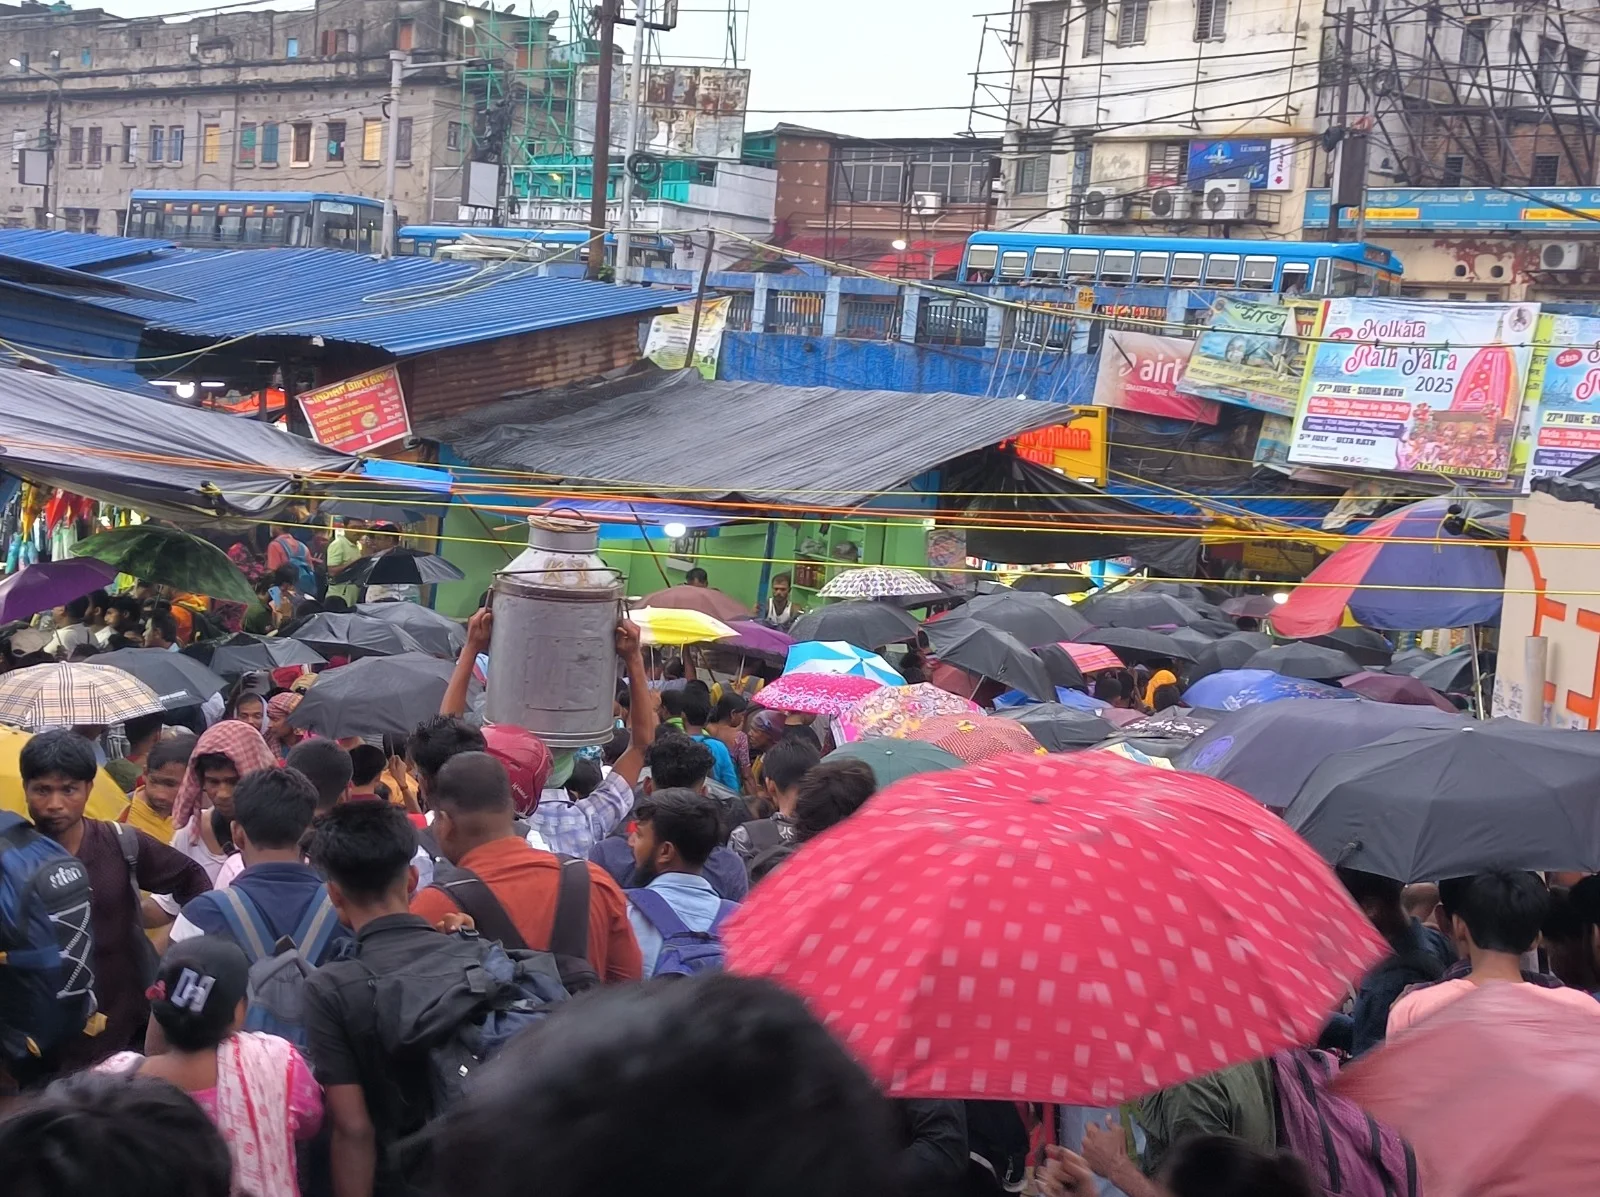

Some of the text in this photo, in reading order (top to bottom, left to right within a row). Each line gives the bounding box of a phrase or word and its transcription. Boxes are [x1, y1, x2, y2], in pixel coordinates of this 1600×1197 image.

[1357, 318, 1426, 339] Kolkata
[1345, 344, 1458, 376] Rath Yatra
[1140, 353, 1184, 386] airt
[1125, 383, 1168, 397] SMARTPHONE
[1333, 385, 1352, 394] JUNE
[1383, 388, 1405, 398] RATH
[1414, 376, 1455, 394] 2025
[1564, 413, 1585, 424] JUNE
[1540, 428, 1561, 439] Mela
[1312, 435, 1329, 443] JULY
[1356, 439, 1377, 447] RATH
[1436, 465, 1457, 475] ARE
[1459, 467, 1504, 479] INVITED
